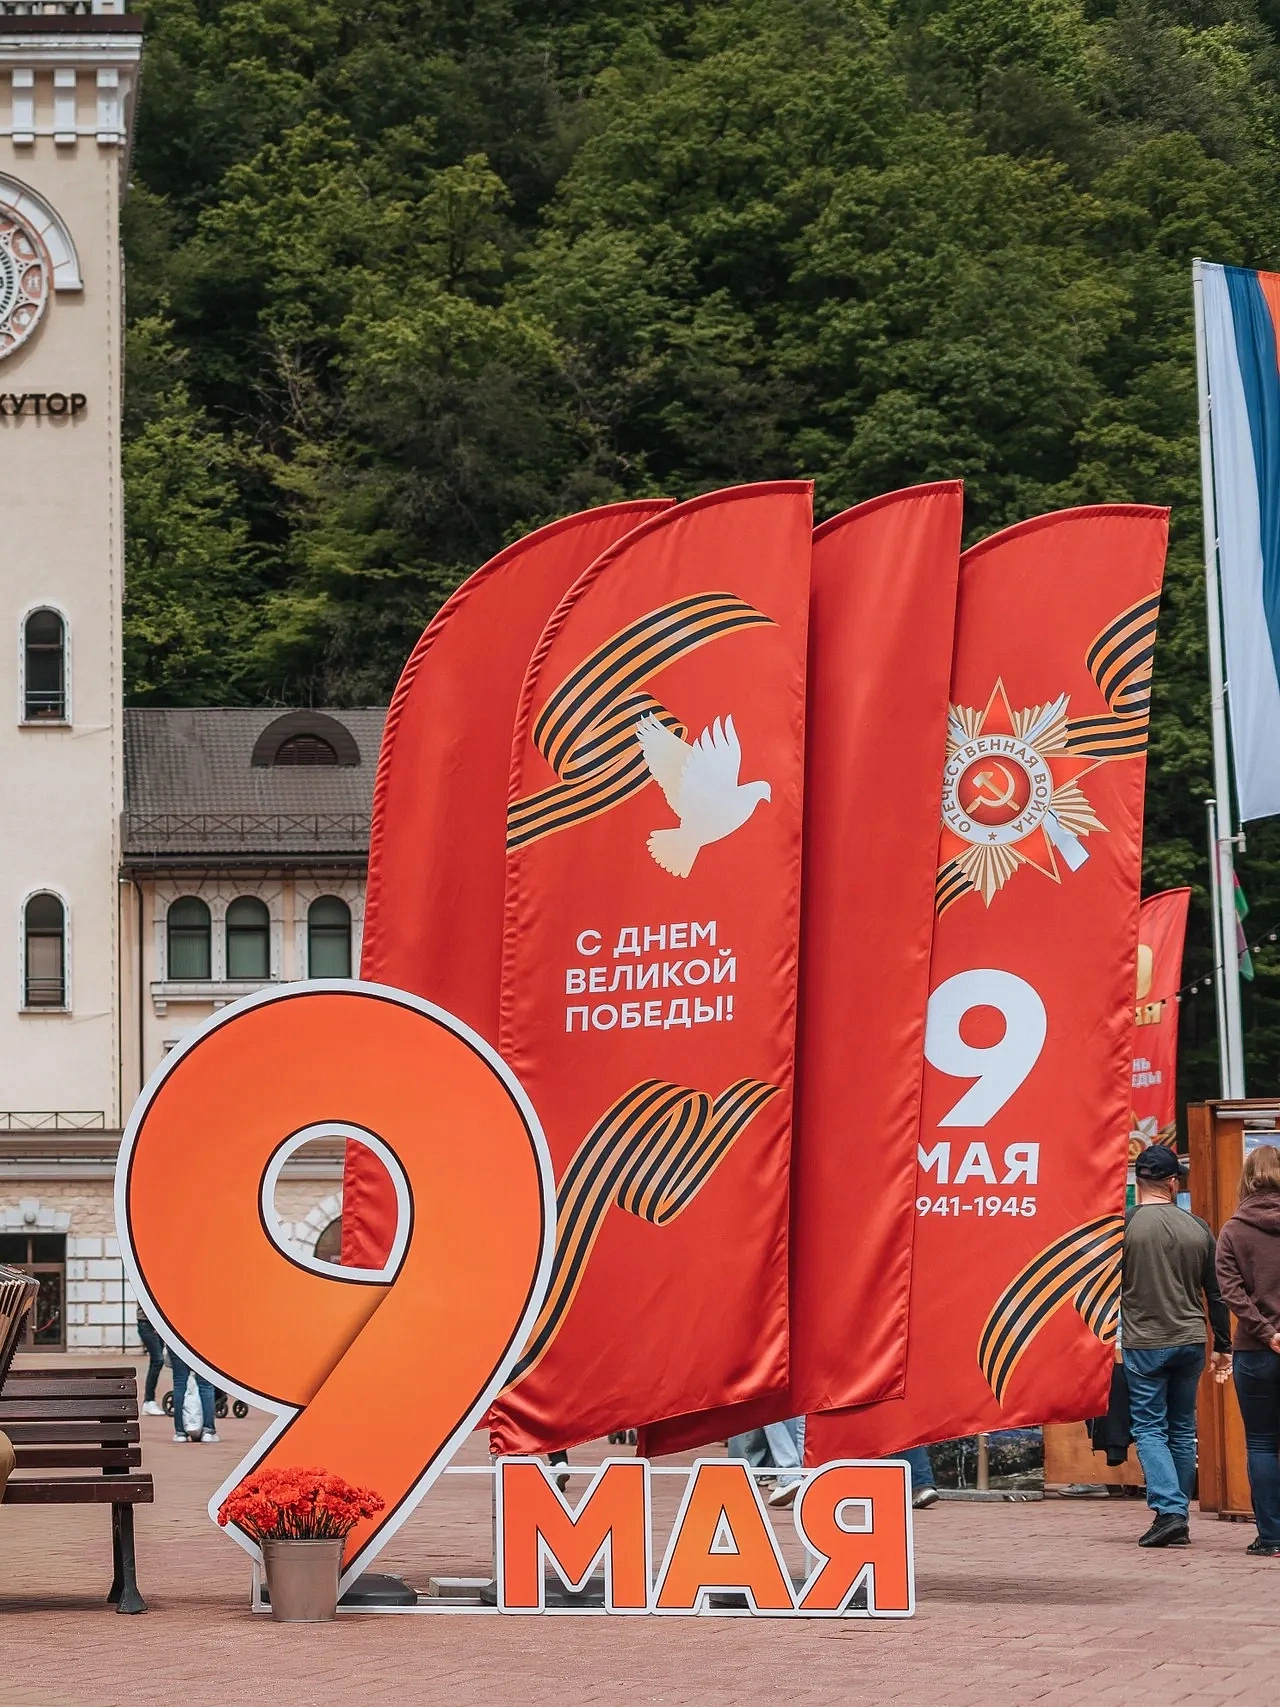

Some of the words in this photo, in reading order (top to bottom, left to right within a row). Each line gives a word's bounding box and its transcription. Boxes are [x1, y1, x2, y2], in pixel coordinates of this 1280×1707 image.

[942, 739, 1040, 833] ОТЕЧЕСТВЕННАЯ
[1012, 772, 1048, 834] ВОЙНА
[576, 929, 602, 956] С
[613, 920, 717, 958] ДНЕМ
[565, 948, 736, 995] ВЕЛИКОЙ
[565, 995, 734, 1033] ПОБЕДЫ!
[924, 968, 1048, 1128] 9
[917, 1141, 1040, 1185] МАЯ
[915, 1195, 1037, 1217] 941-1945
[114, 978, 558, 1602] 9
[495, 1456, 916, 1618] МАЯ
